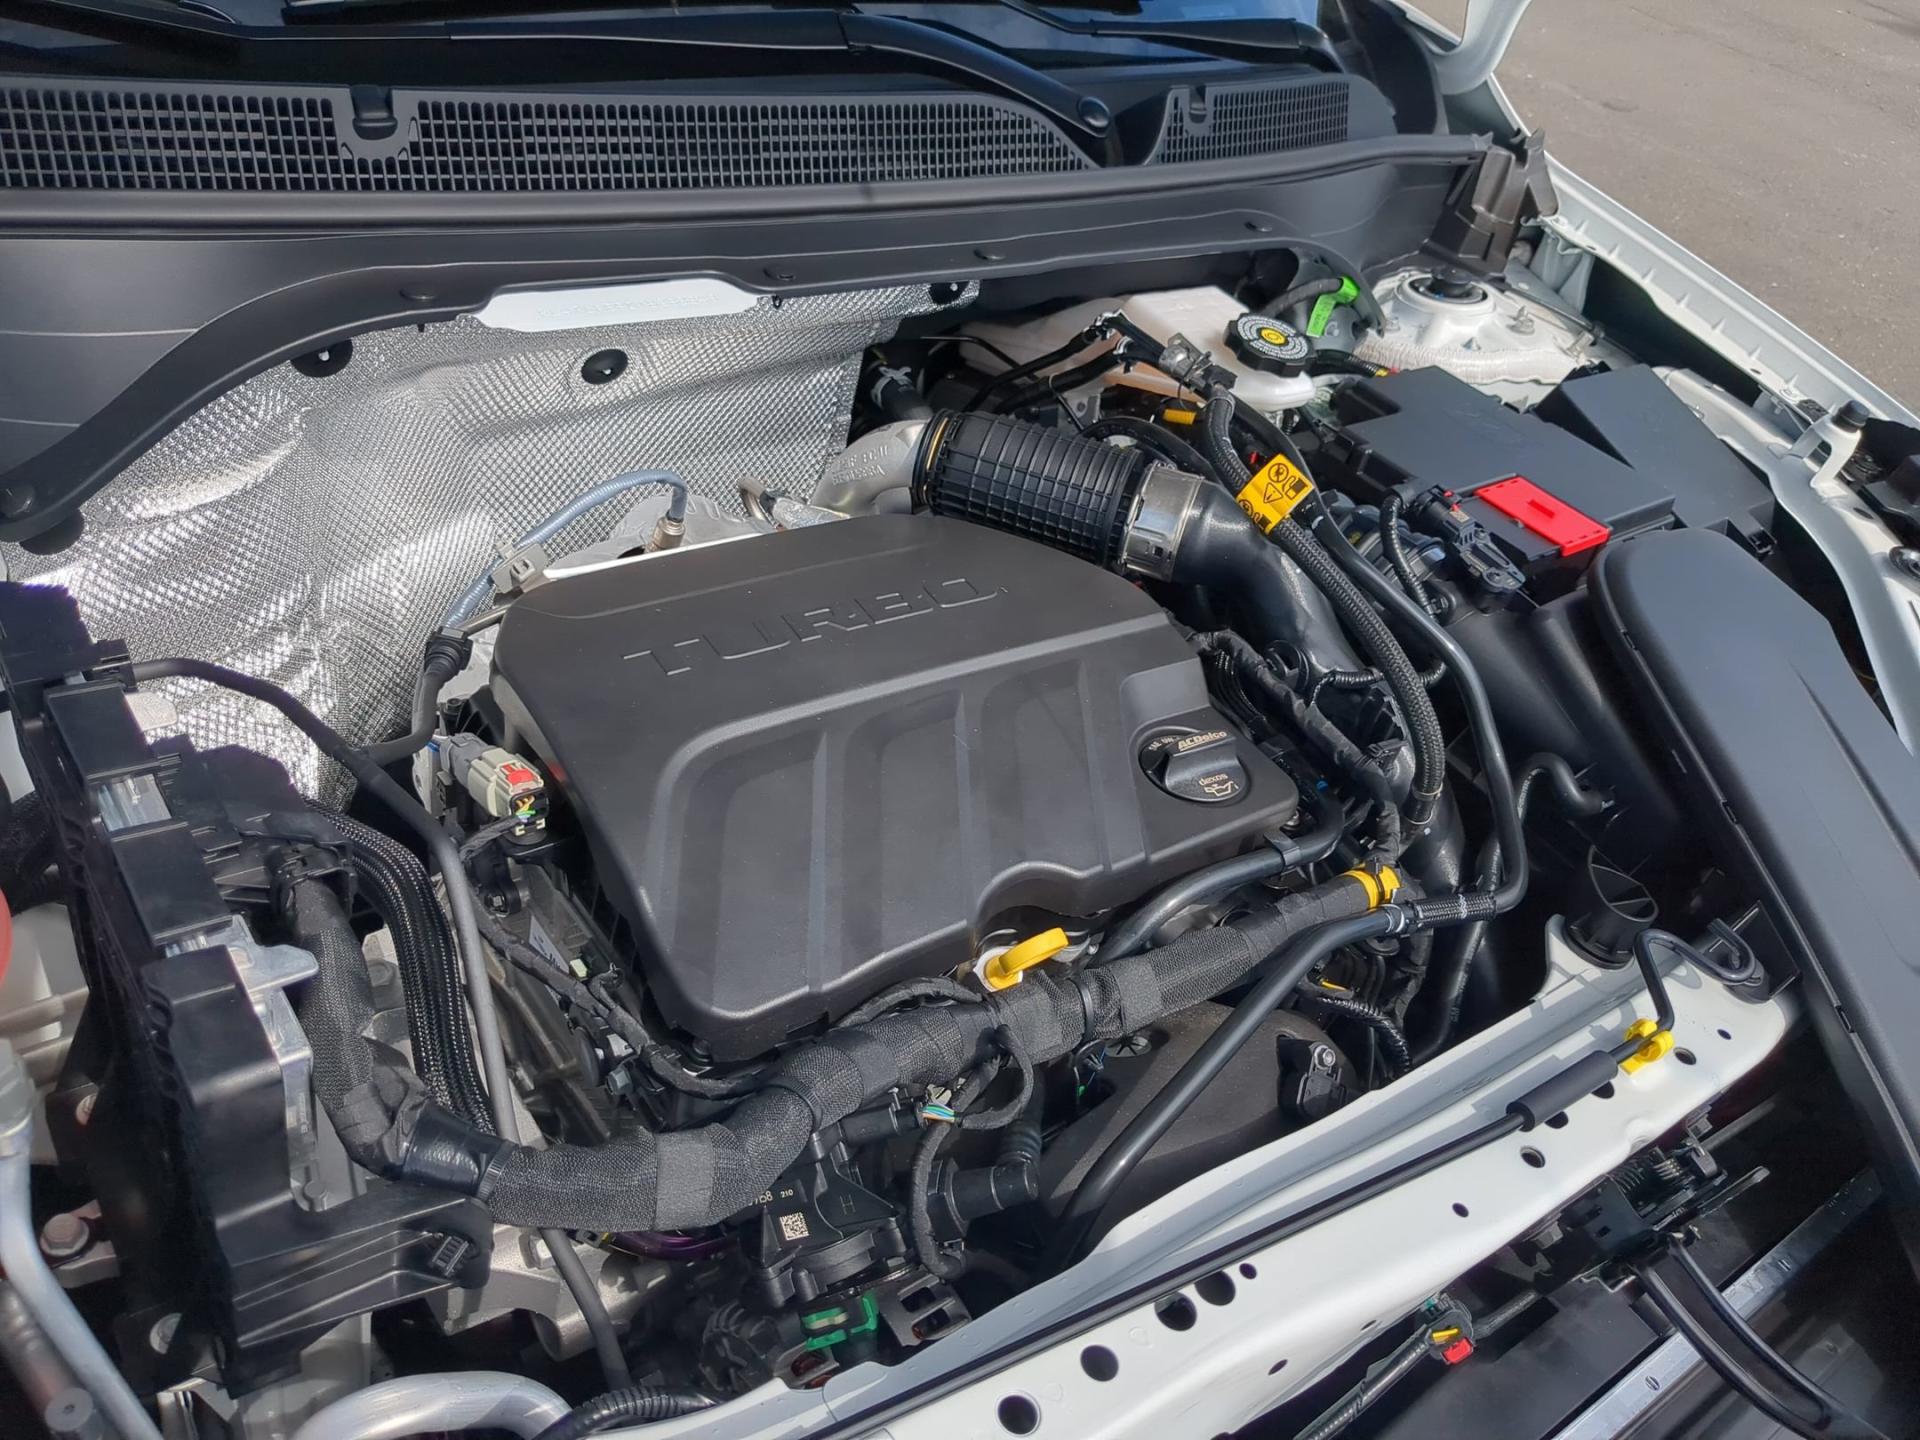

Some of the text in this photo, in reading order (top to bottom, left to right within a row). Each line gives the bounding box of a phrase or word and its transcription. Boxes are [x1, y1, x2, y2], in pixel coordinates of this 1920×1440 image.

[623, 578, 1007, 675] TURBO
[1178, 731, 1227, 750] ACDelco
[1198, 773, 1228, 786] dexos
[781, 1188, 794, 1198] 210
